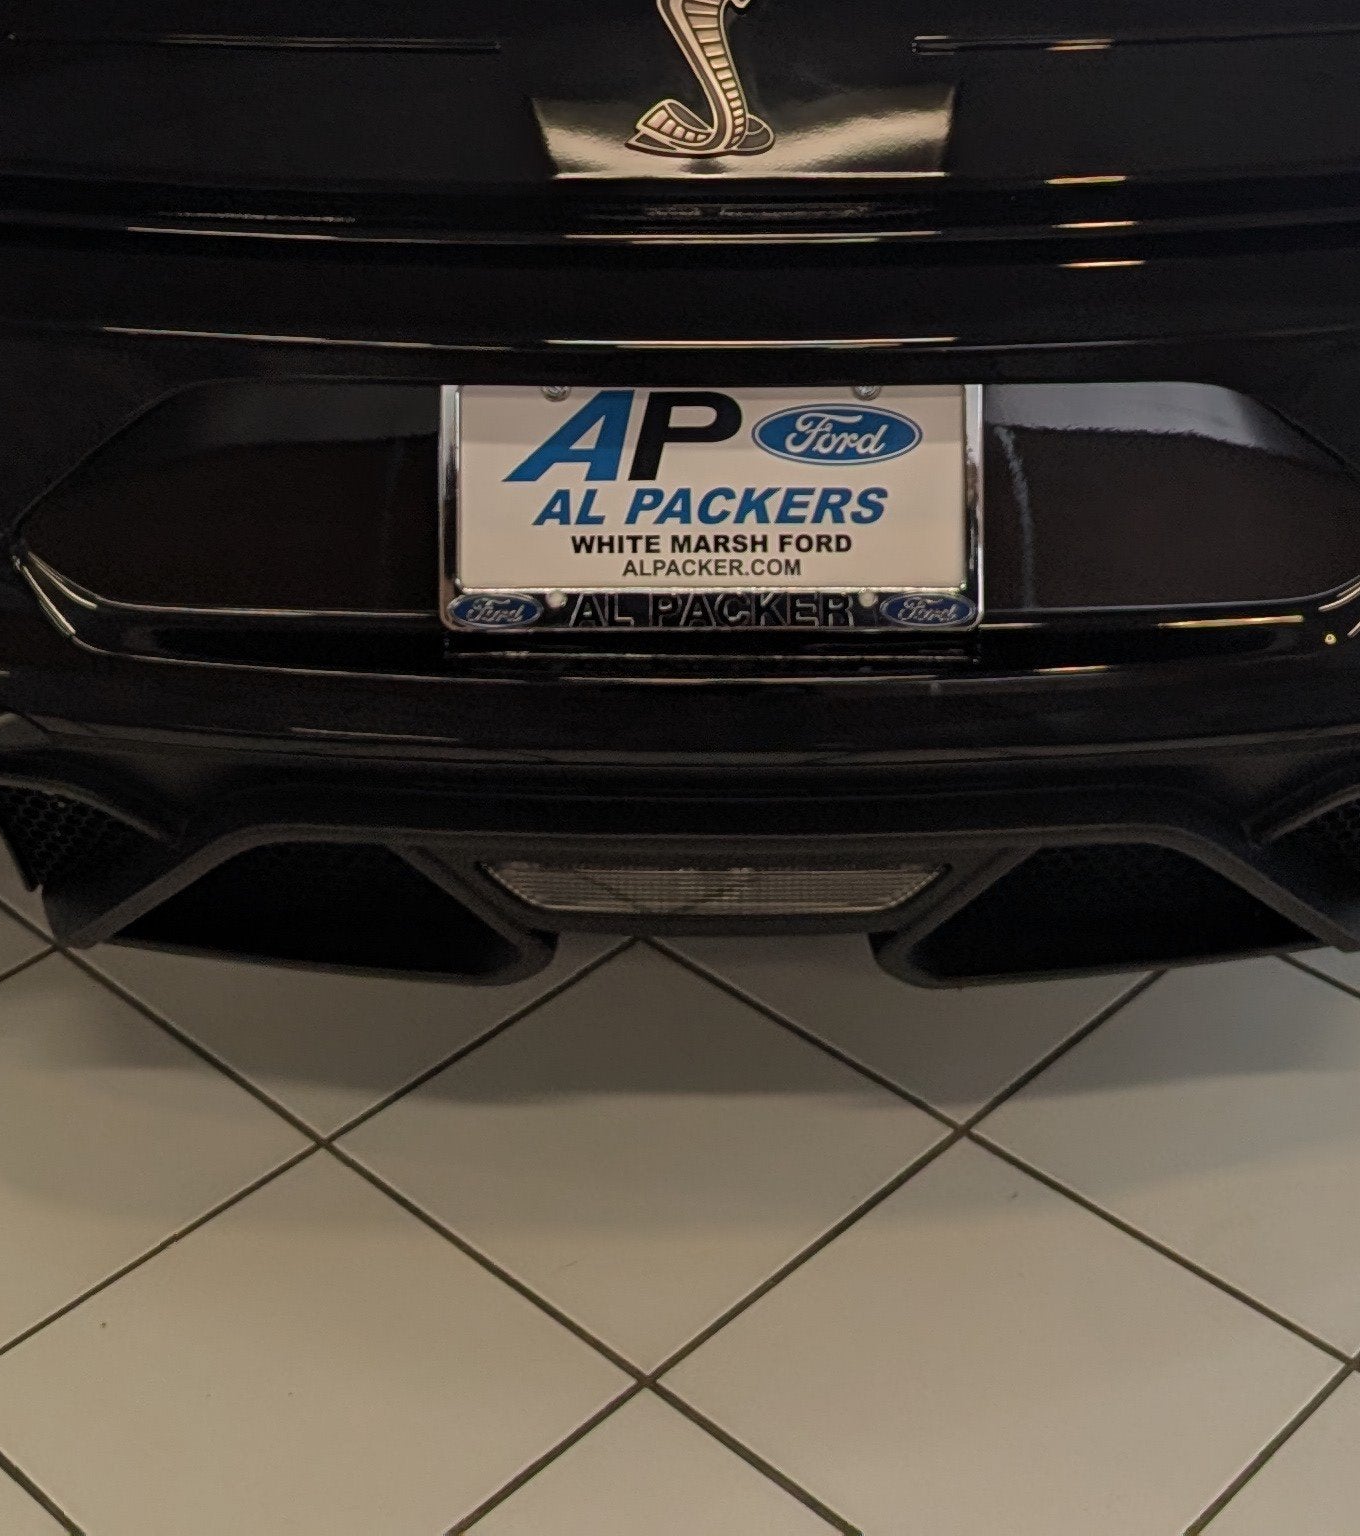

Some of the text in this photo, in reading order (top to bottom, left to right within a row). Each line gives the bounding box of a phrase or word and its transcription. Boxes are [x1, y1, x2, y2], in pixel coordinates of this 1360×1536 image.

[501, 389, 742, 482] AP
[785, 412, 889, 455] Ford
[531, 486, 889, 525] AL PACKERS
[571, 534, 853, 554] WHITE MARSH FORD
[621, 558, 802, 577] ALPACKER.COM
[568, 591, 856, 628] AL PACKER
